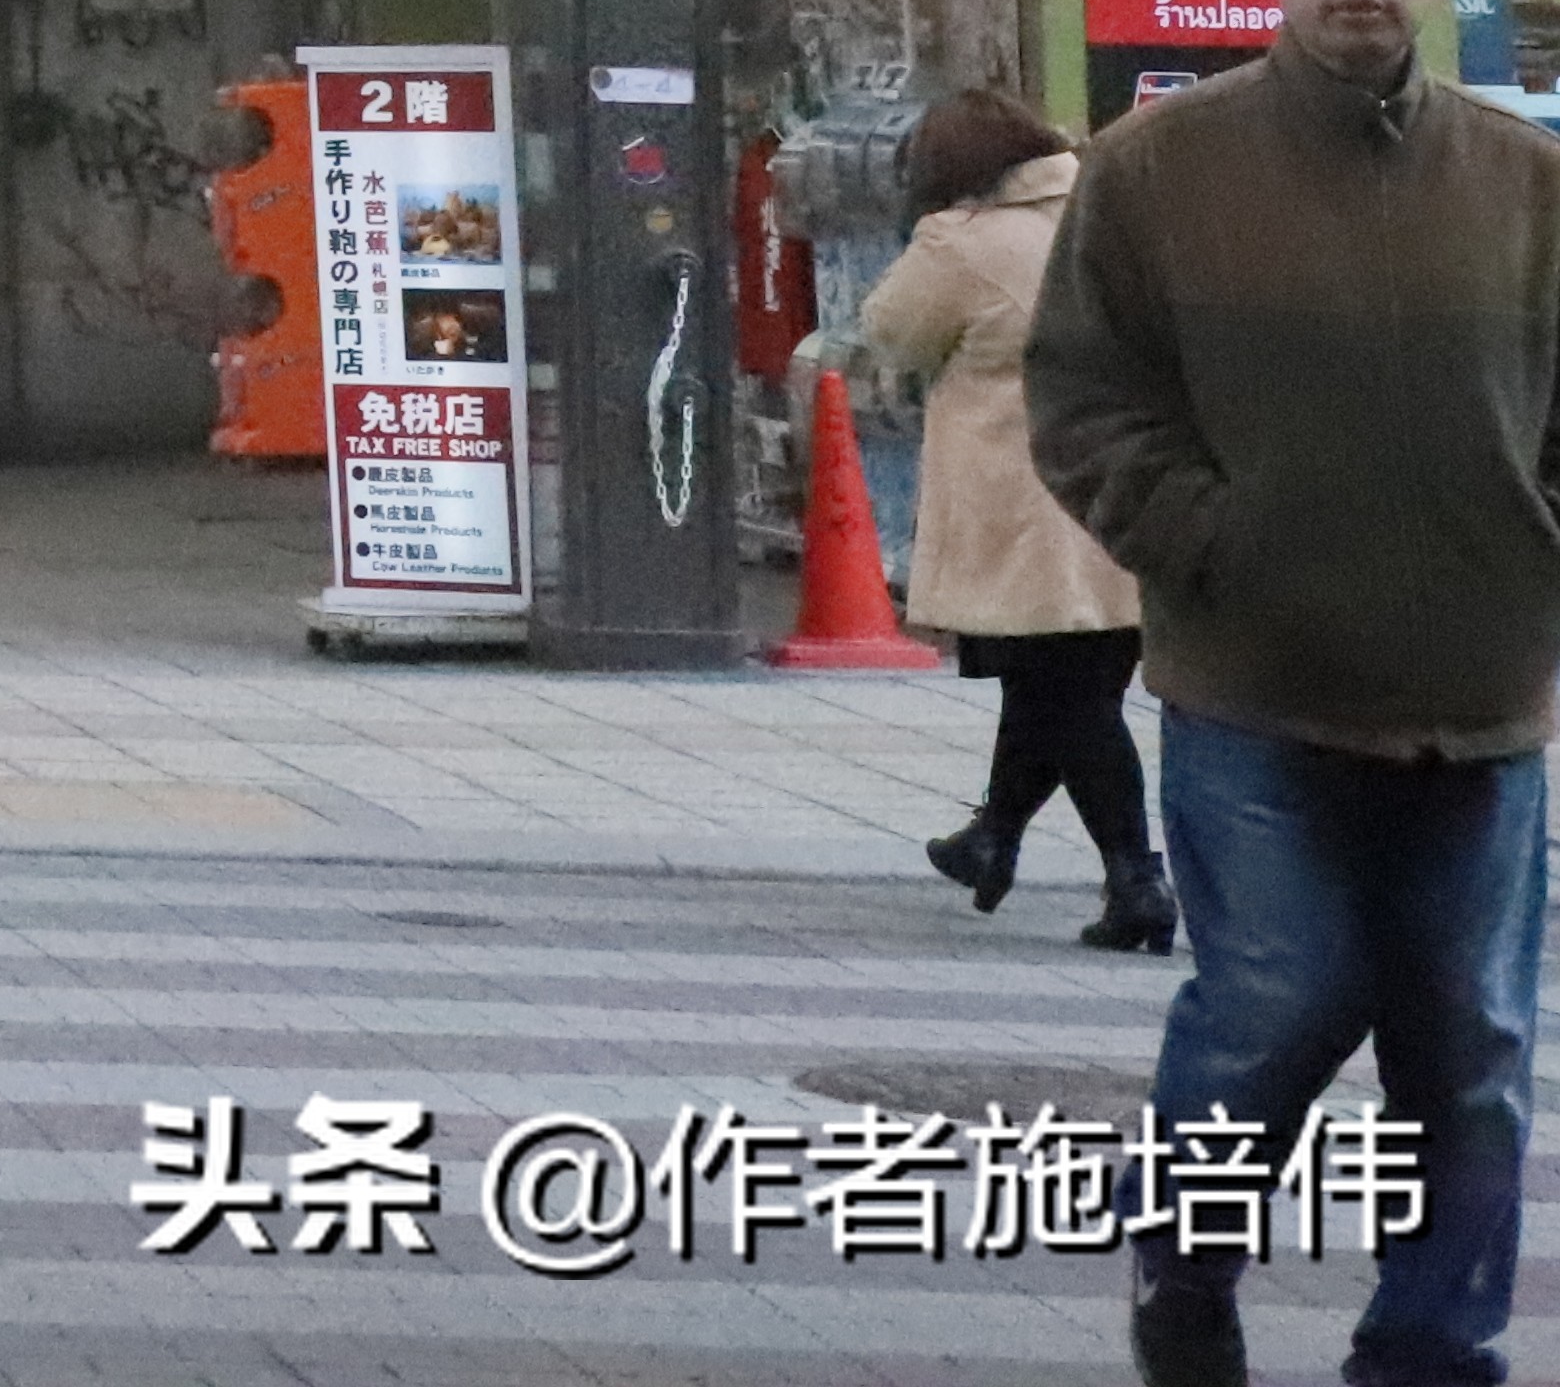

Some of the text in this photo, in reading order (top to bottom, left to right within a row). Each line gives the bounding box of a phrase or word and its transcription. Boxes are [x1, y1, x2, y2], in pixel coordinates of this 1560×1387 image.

[360, 80, 449, 124] 2階
[363, 170, 389, 256] 水芭蕉
[324, 138, 363, 376] 手作り鞄の専門店
[372, 262, 389, 314] 札幌店
[358, 391, 485, 435] 免税店
[346, 436, 503, 458] TAX FREE SHOP
[422, 486, 474, 499] Products
[431, 525, 482, 537] Products
[372, 562, 396, 572] Cow
